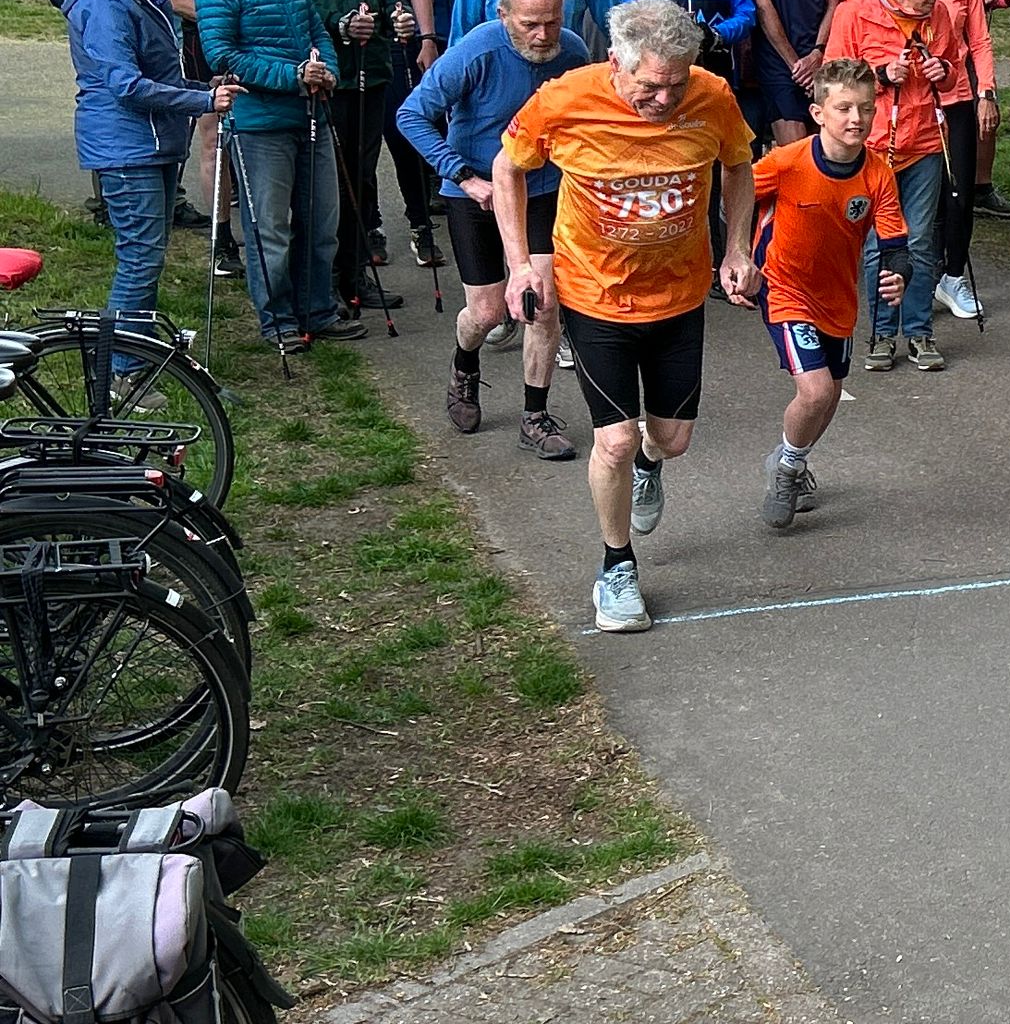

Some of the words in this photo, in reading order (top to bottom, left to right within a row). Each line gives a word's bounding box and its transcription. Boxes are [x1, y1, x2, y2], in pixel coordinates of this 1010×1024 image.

[610, 174, 682, 191] GOUDA
[611, 188, 684, 218] 750
[600, 222, 640, 241] 1272
[658, 216, 694, 238] 2022
